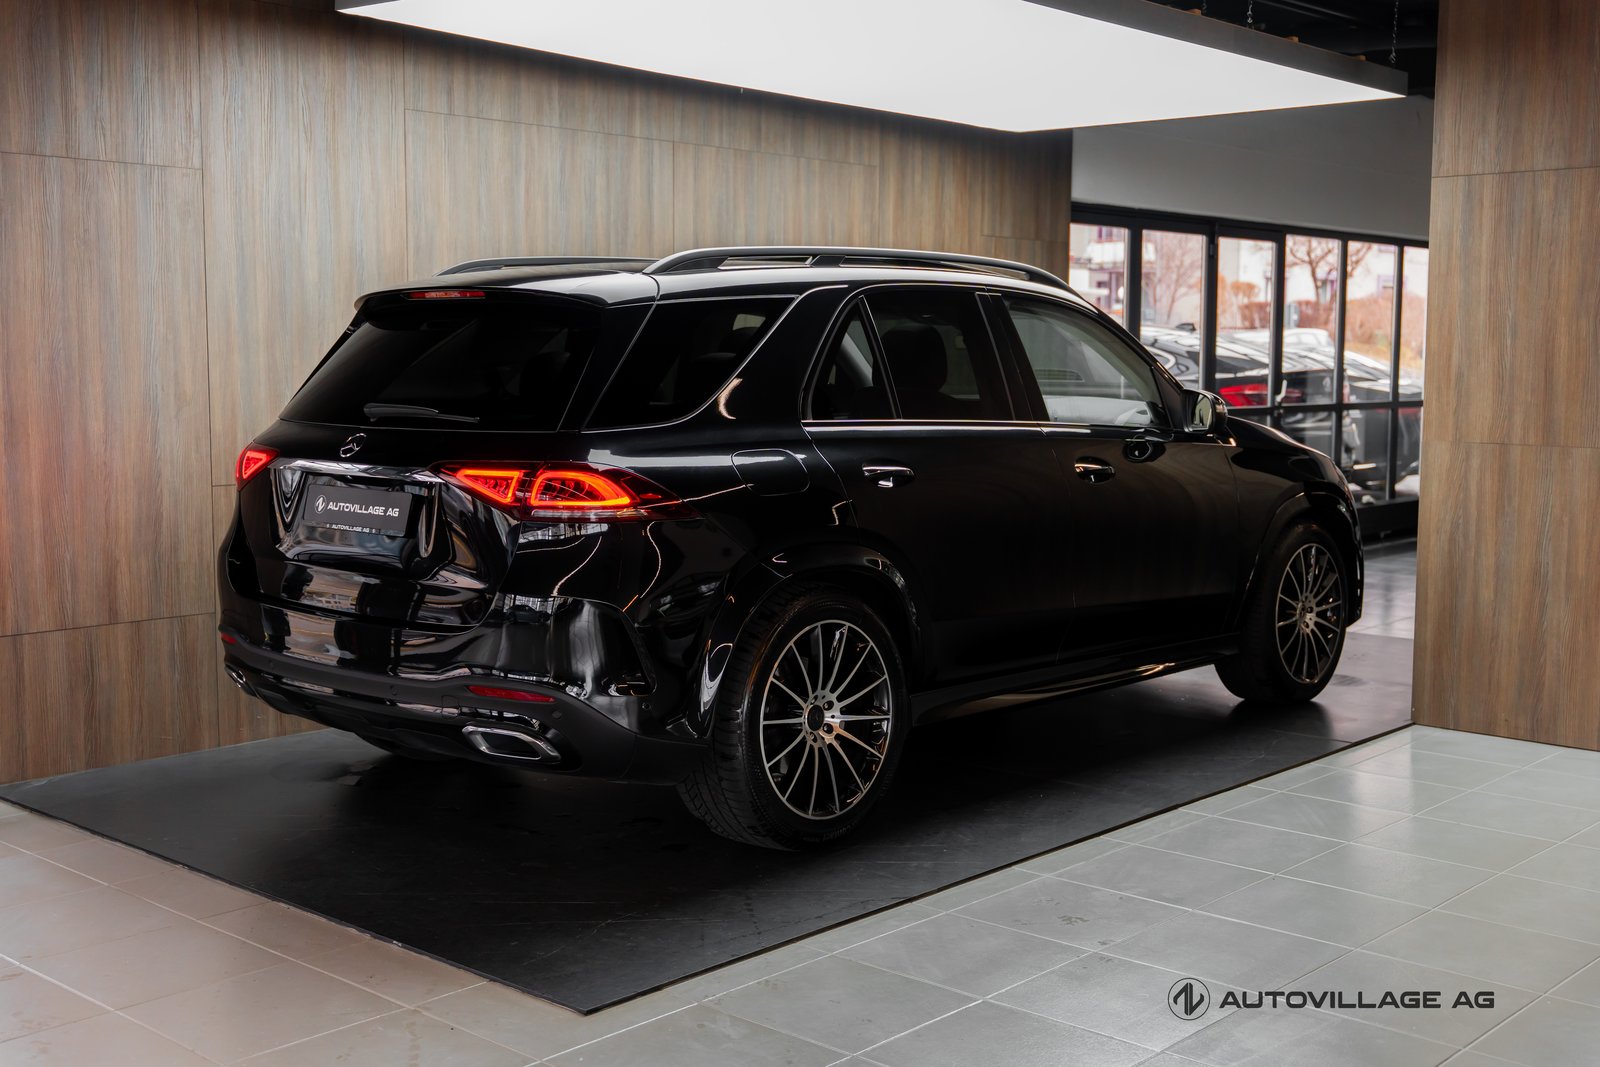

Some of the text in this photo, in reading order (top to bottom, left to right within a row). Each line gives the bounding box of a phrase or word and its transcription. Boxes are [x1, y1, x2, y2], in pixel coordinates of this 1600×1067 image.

[327, 502, 400, 517] AUTOVILLAGE AG
[331, 524, 362, 532] AUTOVILLAGE
